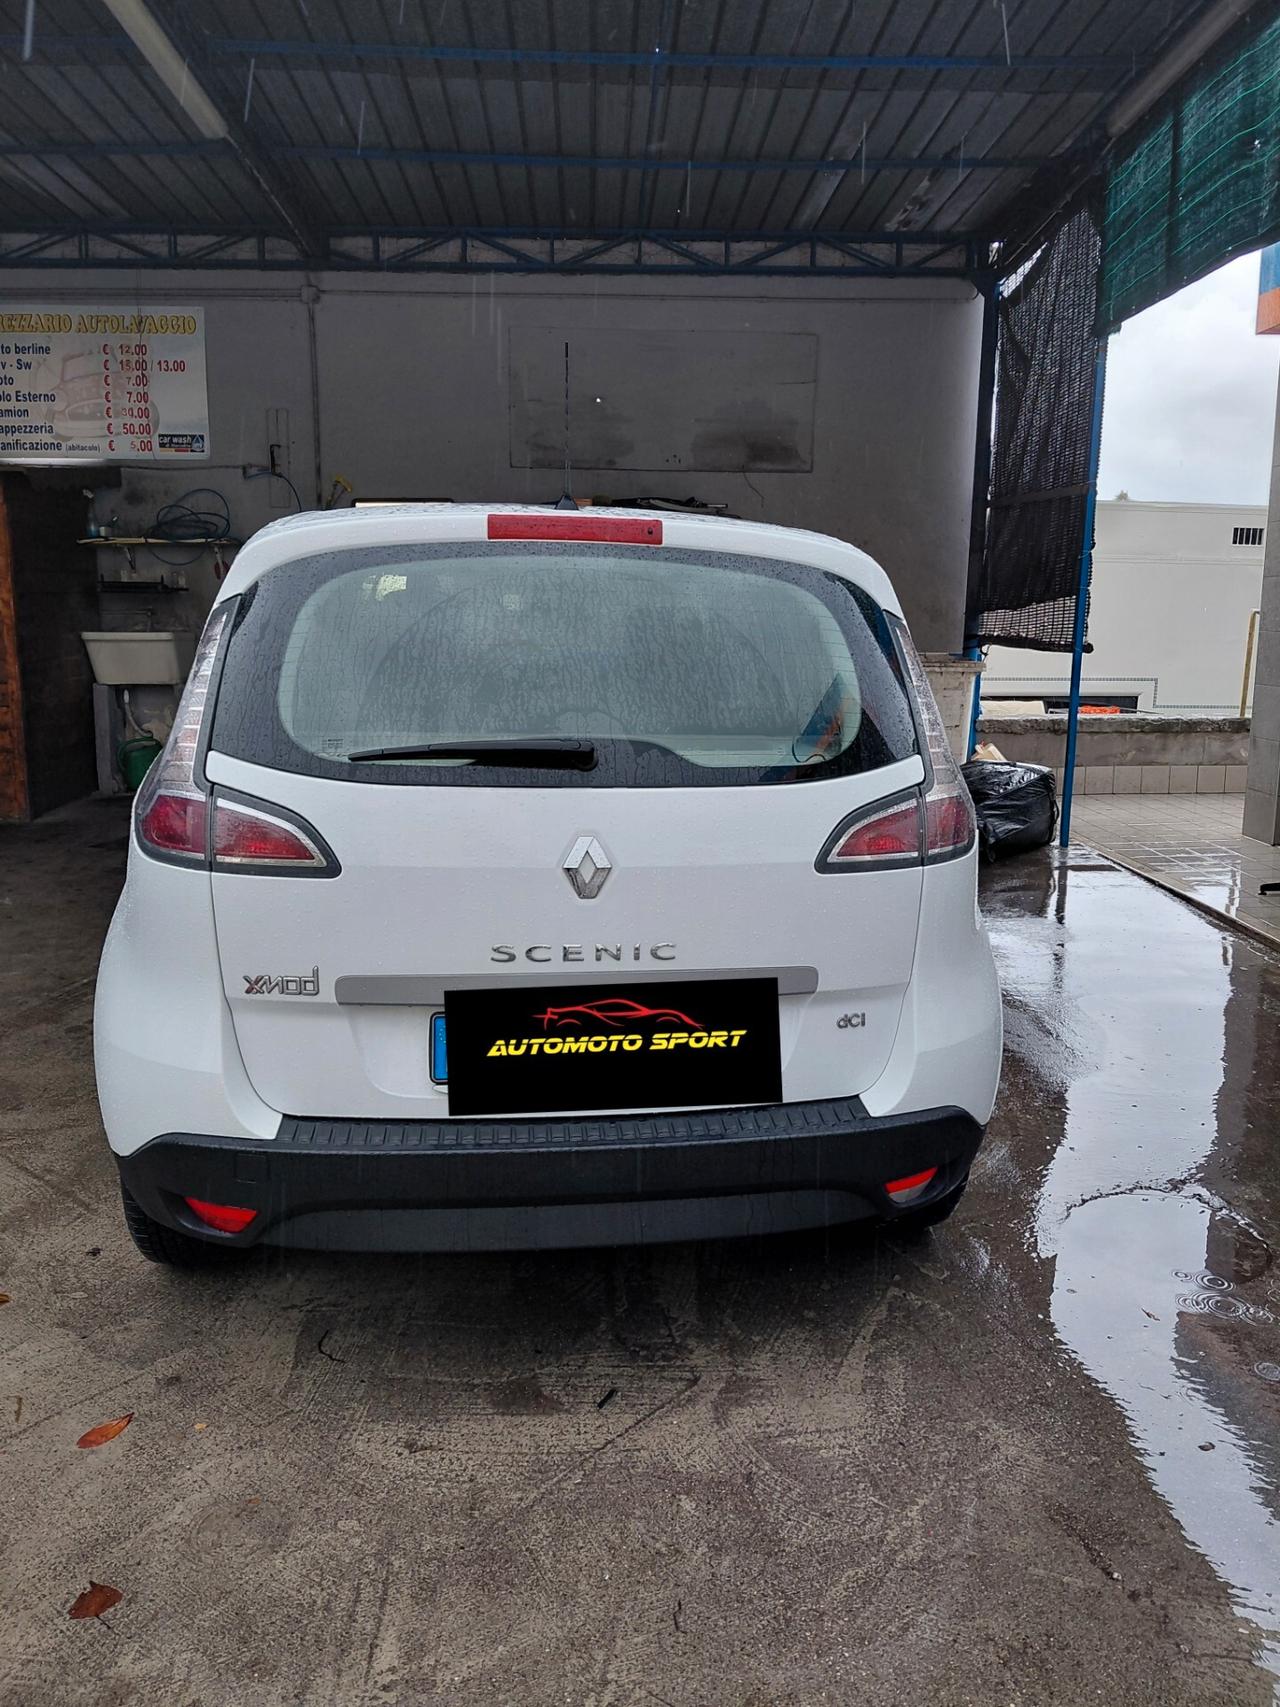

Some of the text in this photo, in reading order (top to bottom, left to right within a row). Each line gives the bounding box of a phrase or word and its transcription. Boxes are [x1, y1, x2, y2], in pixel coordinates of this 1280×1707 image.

[75, 314, 197, 335] AUTOLAVAGGIO
[14, 343, 51, 355] berline
[102, 344, 109, 355] €
[118, 344, 148, 356] 12.00
[16, 359, 32, 371] Sw
[103, 360, 110, 371] €
[157, 360, 186, 372] 13.00
[104, 375, 111, 386] €
[126, 375, 149, 386] 7.00
[15, 391, 56, 402] Esterno
[104, 391, 112, 403] €
[126, 392, 149, 403] 7.00
[105, 407, 112, 418] €
[106, 423, 114, 434] €
[122, 423, 151, 435] 50.00
[1, 439, 63, 451] anificazione
[108, 440, 115, 451] €
[172, 435, 192, 443] wash
[490, 943, 677, 963] SCENIC
